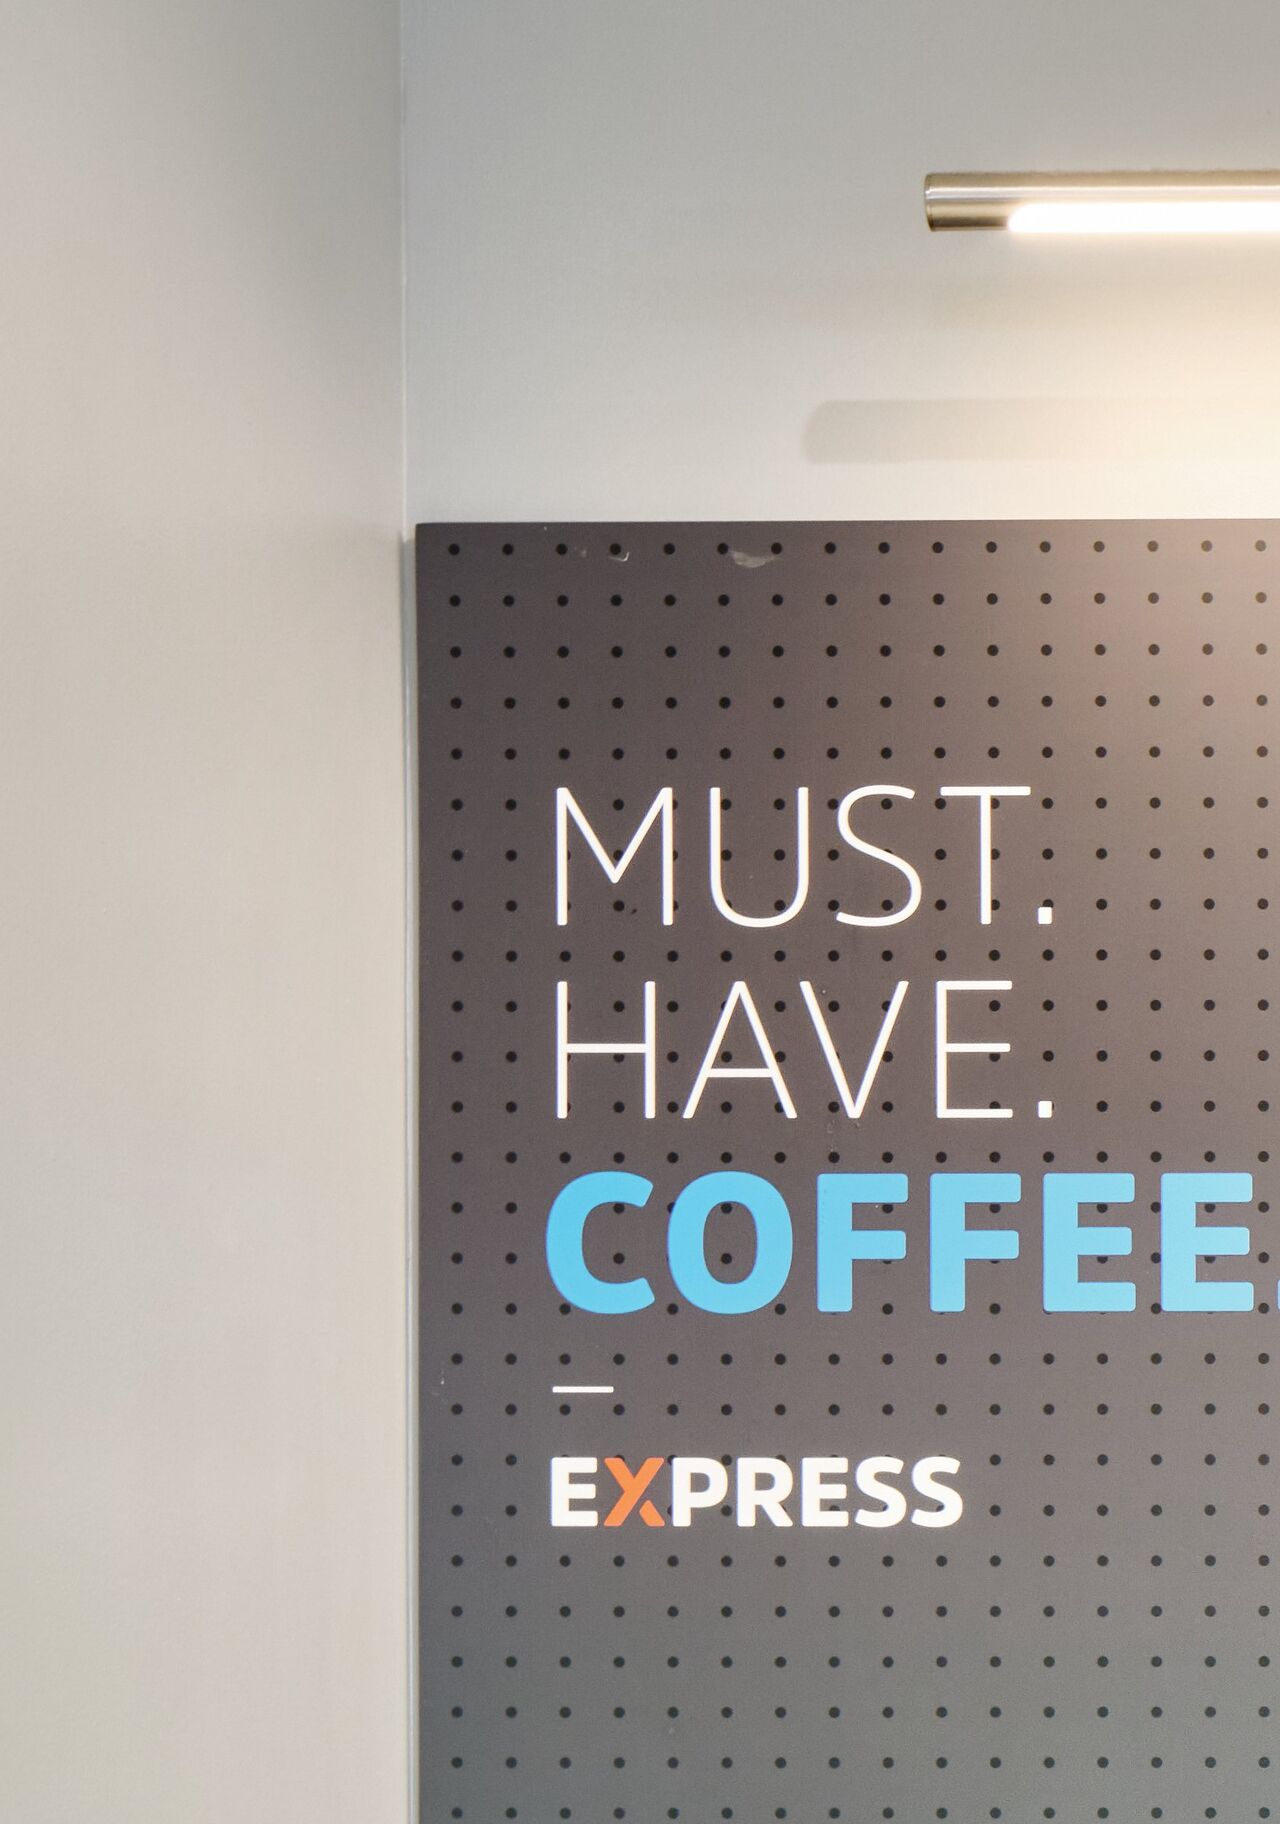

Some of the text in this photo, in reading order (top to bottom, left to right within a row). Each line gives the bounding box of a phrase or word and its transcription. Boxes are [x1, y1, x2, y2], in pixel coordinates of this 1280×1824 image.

[556, 785, 1053, 928] MUST.
[556, 980, 1053, 1120] HAVE.
[550, 1456, 963, 1527] EXPRESS
